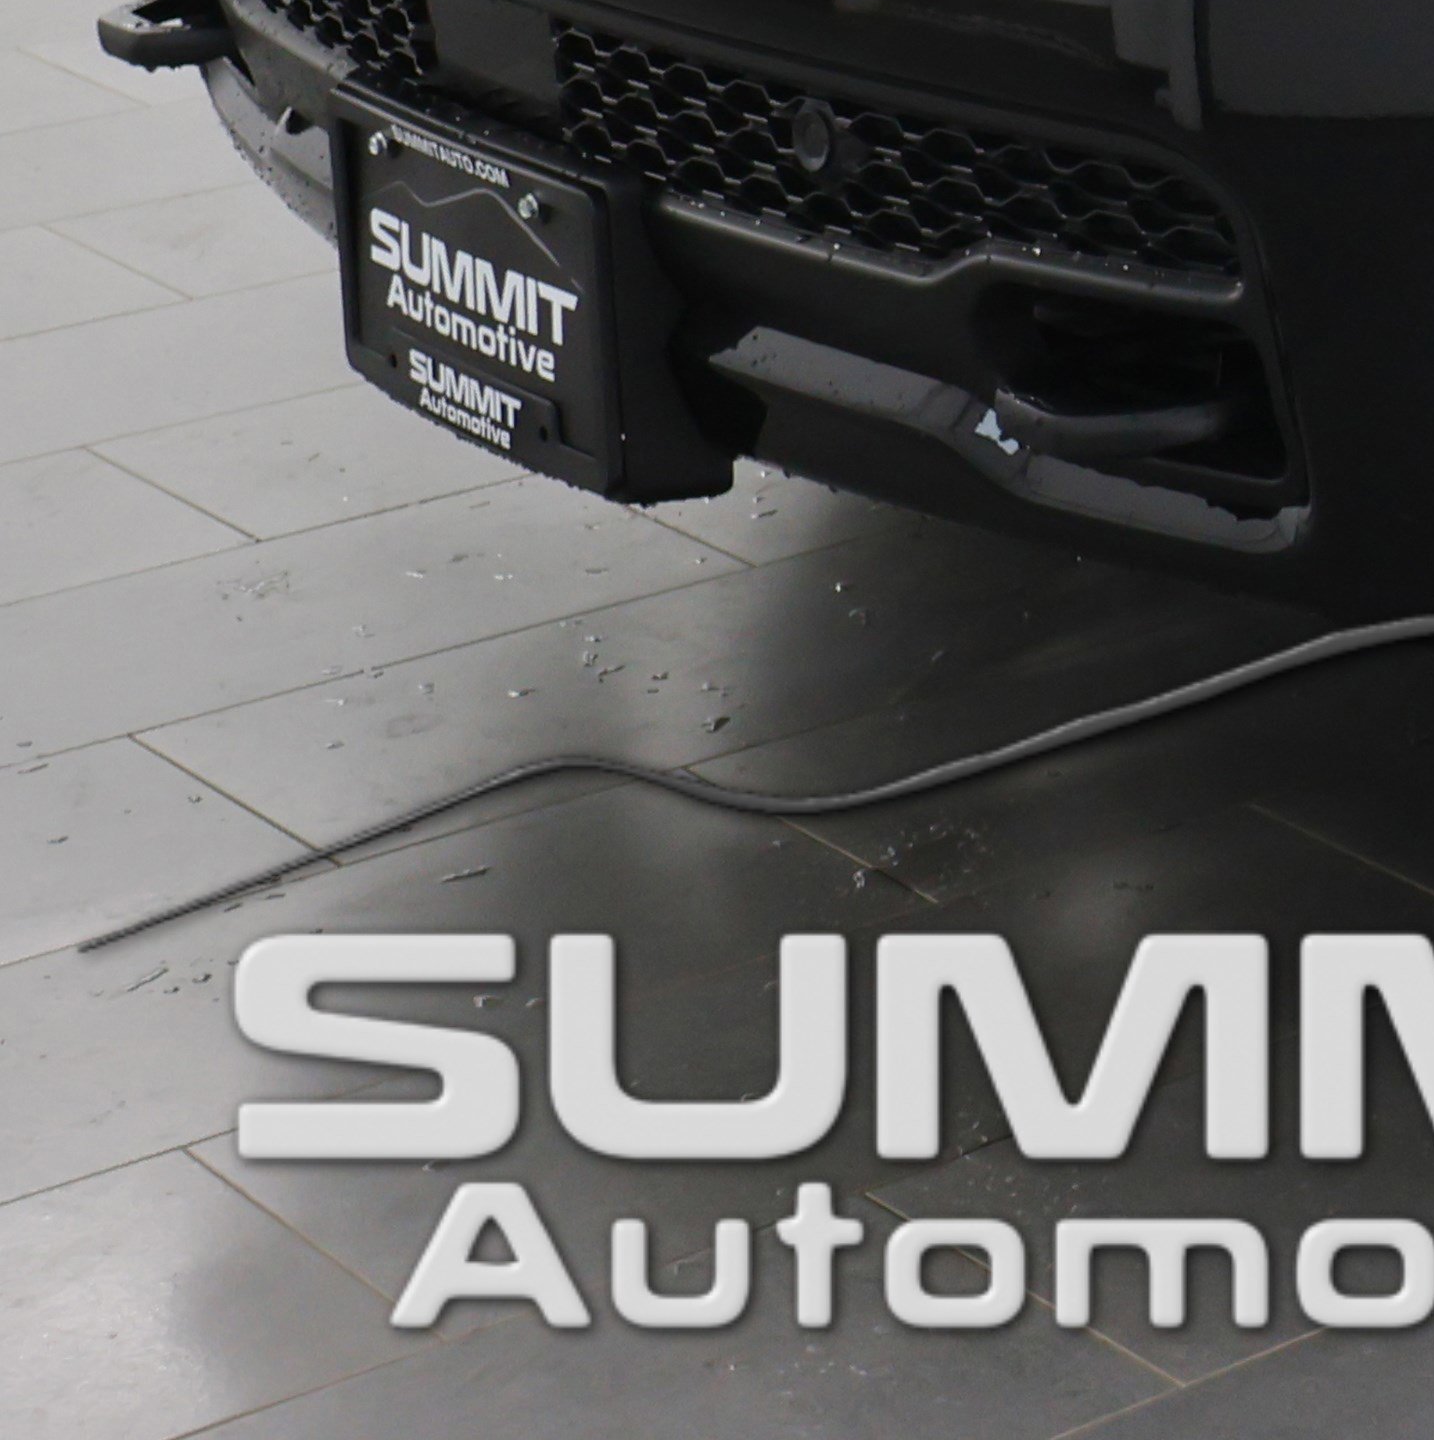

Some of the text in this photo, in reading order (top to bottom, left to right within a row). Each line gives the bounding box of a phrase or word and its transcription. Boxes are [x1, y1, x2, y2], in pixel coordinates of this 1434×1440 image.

[369, 207, 578, 346] SUMMIT
[386, 273, 556, 383] Automotive
[408, 348, 522, 429] SUMMIT
[418, 386, 512, 450] Automotive
